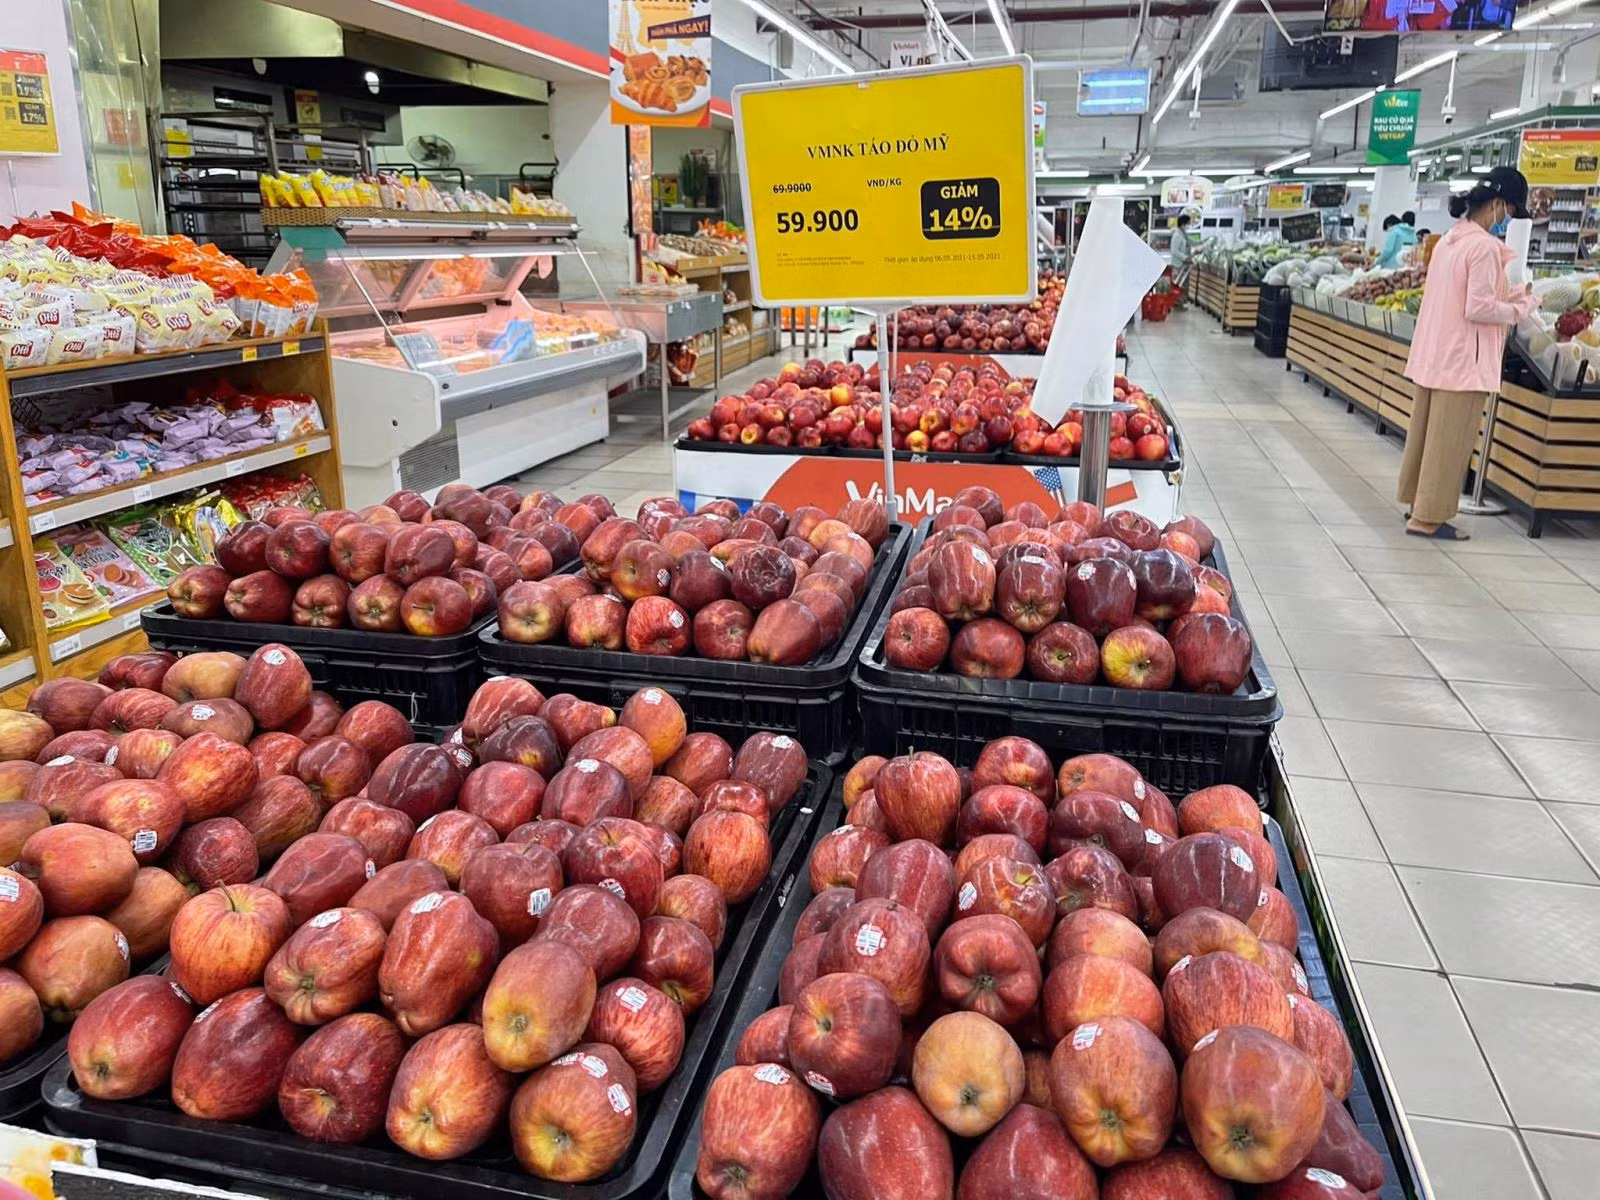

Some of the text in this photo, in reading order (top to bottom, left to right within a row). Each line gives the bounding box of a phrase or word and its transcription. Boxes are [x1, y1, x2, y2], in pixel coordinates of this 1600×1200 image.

[23, 113, 45, 123] 17%
[807, 133, 950, 160] VMNK TÁO ĐỎ MỸ
[773, 182, 812, 194] 69.9000
[940, 182, 978, 199] GIẢM
[776, 208, 859, 233] 59.900
[929, 206, 993, 232] 14%
[846, 480, 954, 515] VinMa
